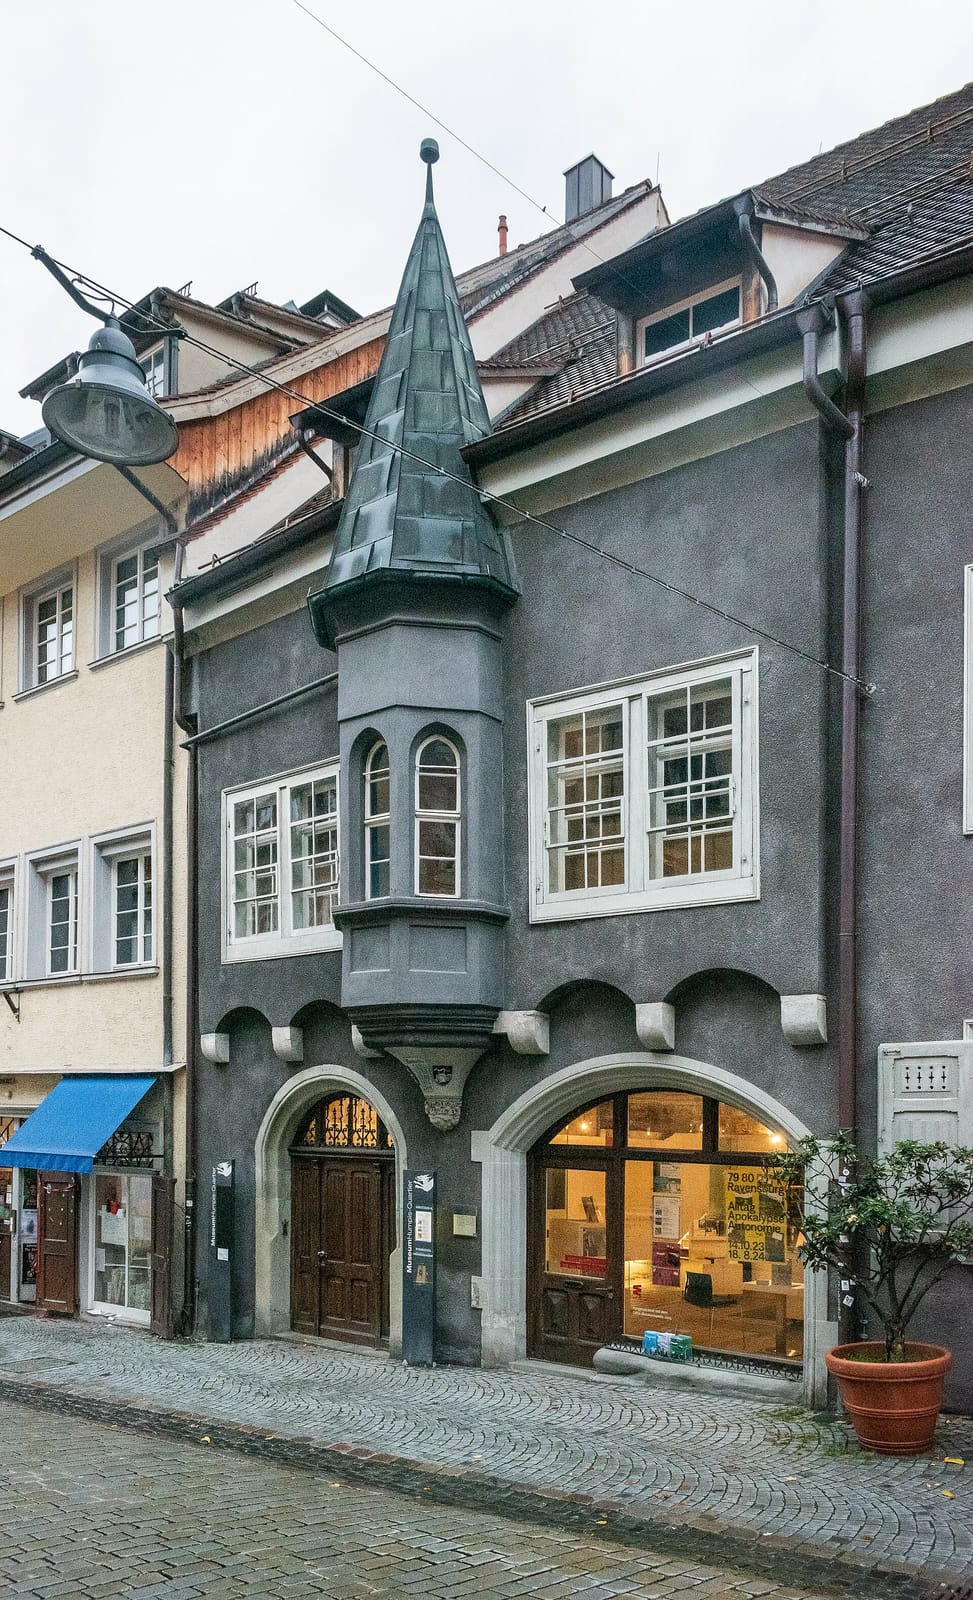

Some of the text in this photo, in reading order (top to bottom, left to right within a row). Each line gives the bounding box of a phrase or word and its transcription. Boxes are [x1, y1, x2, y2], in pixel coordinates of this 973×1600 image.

[727, 1173, 739, 1182] 79
[741, 1173, 755, 1183] 80
[727, 1182, 785, 1196] Ravensburg
[728, 1201, 756, 1214] Alltag
[728, 1211, 785, 1225] Apokalypse
[728, 1221, 781, 1233] Autonomie
[729, 1241, 765, 1251] 14.10.23
